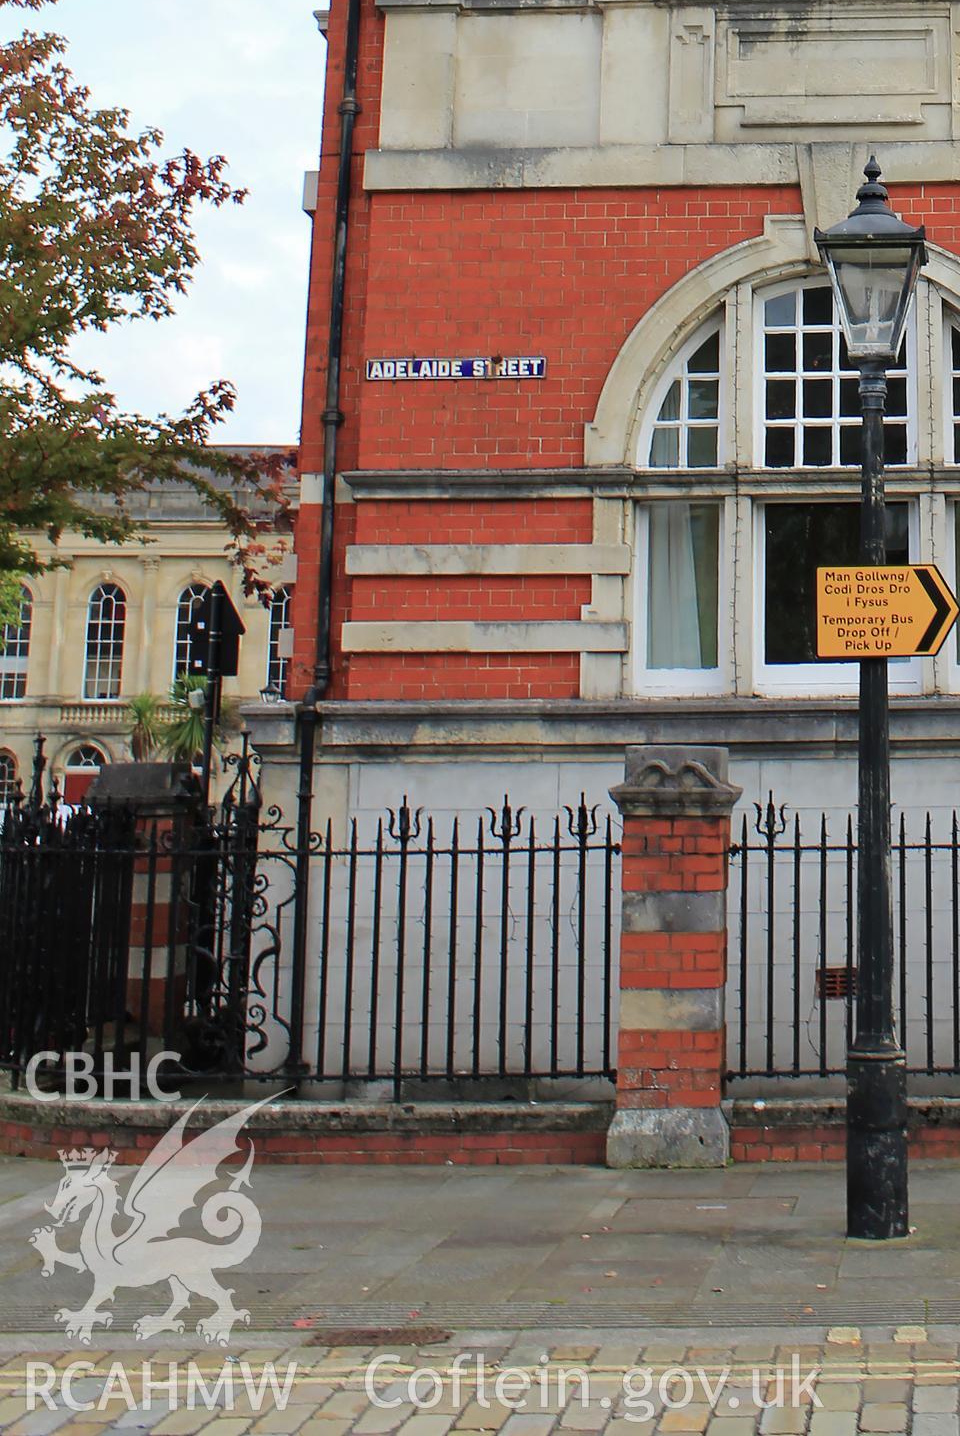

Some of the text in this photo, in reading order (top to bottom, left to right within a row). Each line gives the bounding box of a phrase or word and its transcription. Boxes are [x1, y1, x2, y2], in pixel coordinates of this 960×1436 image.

[370, 359, 541, 378] ADELAIDE STREET
[825, 571, 909, 583] Man Gollwng/
[825, 584, 911, 594] Codi Dros Dro
[855, 597, 889, 608] Fysus
[823, 614, 913, 626] Temporary Bus
[837, 628, 866, 638] Drop
[871, 627, 890, 637] Off
[845, 640, 892, 651] Pick Up
